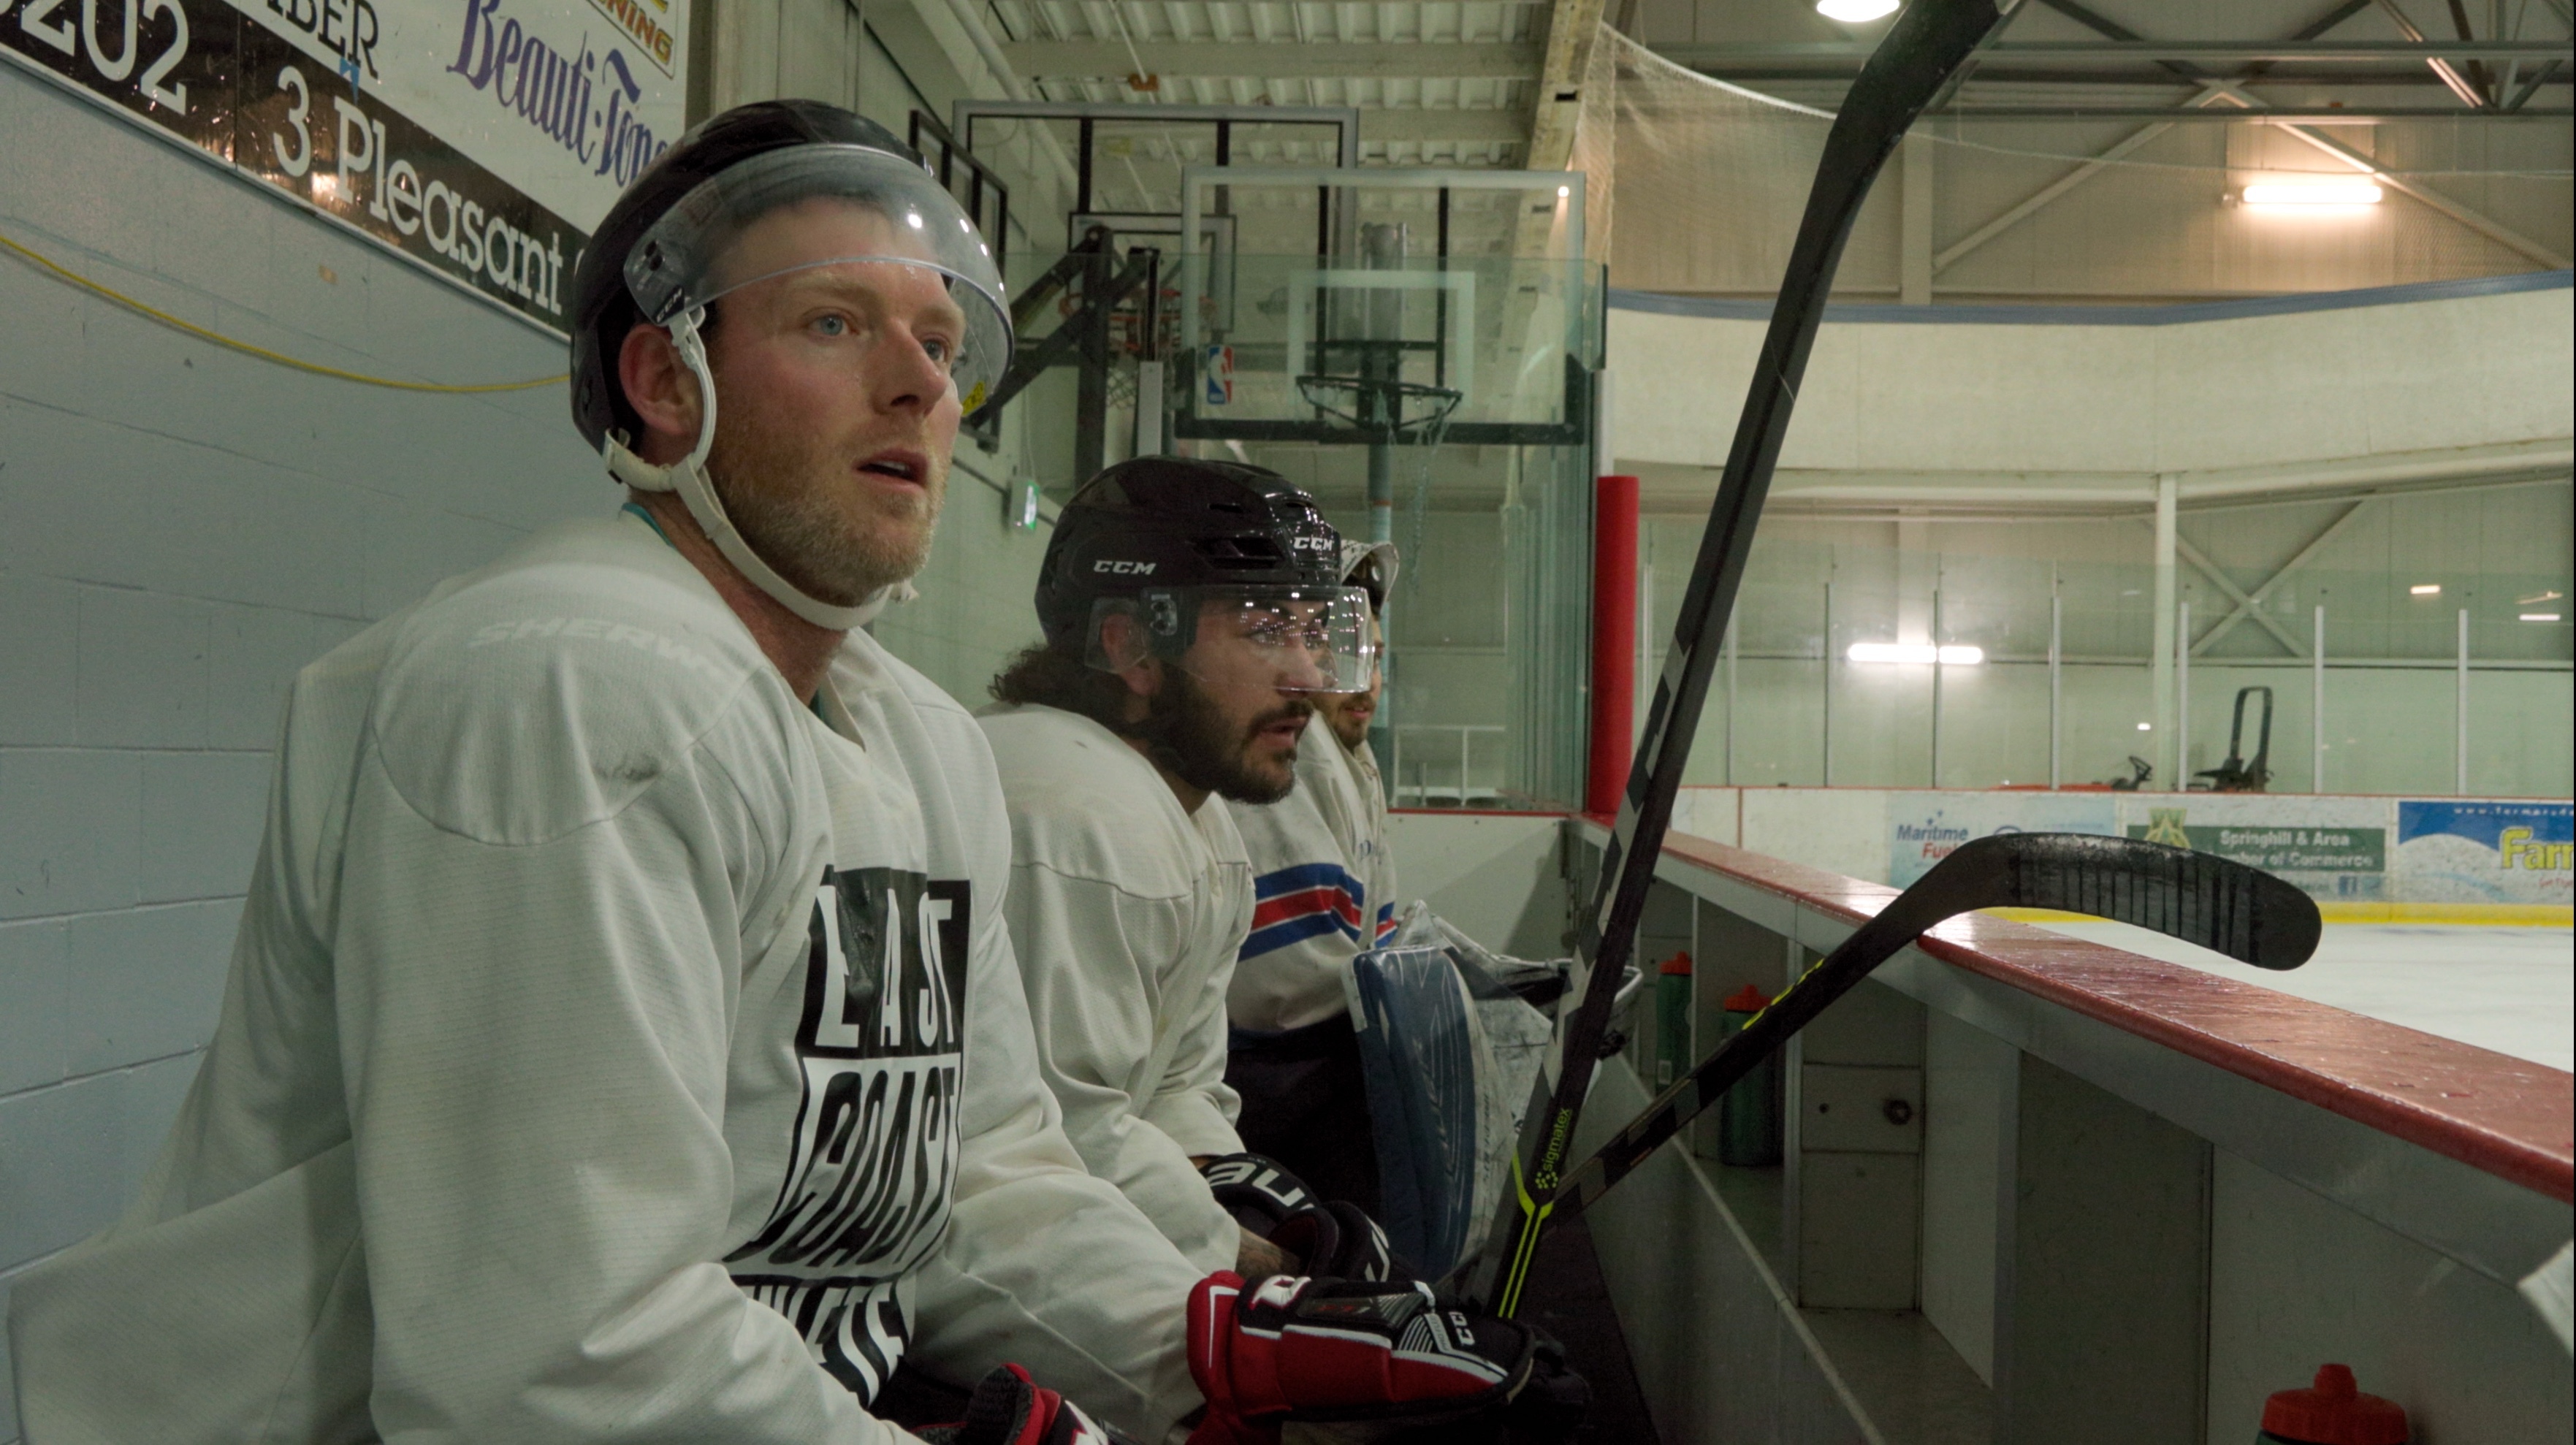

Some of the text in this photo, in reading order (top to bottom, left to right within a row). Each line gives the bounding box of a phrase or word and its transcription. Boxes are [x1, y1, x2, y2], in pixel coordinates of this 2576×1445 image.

[598, 0, 674, 66] NING
[273, 66, 563, 316] 3 Pleasant
[1293, 535, 1335, 552] CCM
[1094, 559, 1156, 576] CCM
[1897, 824, 1968, 841] Maritime
[2220, 829, 2350, 848] Springhill & Area
[2268, 851, 2285, 865] of
[2289, 852, 2373, 866] Commerce
[814, 885, 953, 1049] EAST
[1542, 1107, 1570, 1172] sigmatex
[721, 1066, 956, 1268] COAST
[1448, 1311, 1475, 1346] CC
